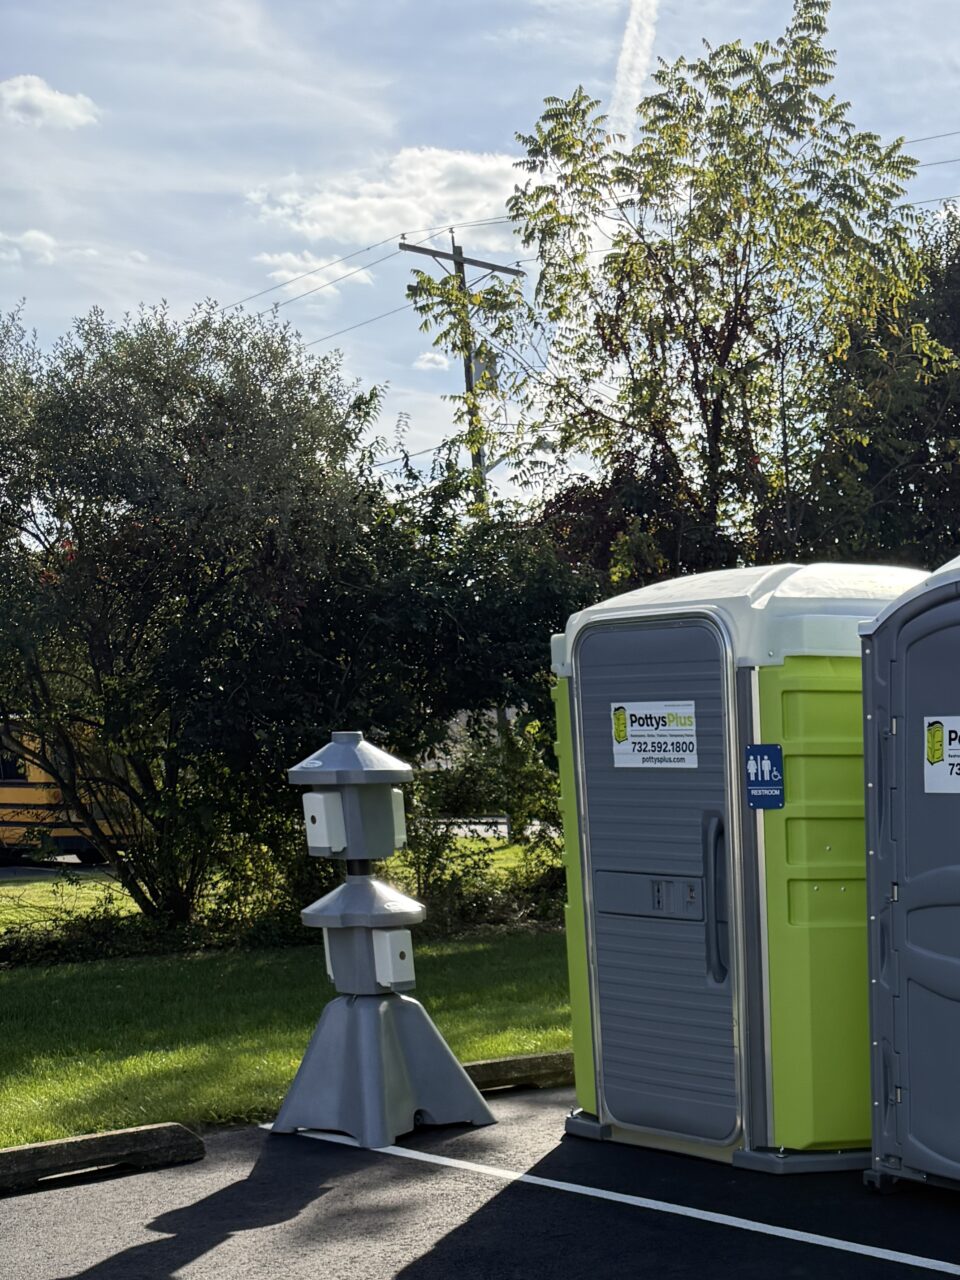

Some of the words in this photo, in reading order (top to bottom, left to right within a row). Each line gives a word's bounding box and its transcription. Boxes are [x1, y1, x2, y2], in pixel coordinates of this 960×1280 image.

[630, 713, 693, 730] PottysPlus
[632, 742, 694, 753] 732.592.1800
[642, 756, 685, 764] pottysplus.com
